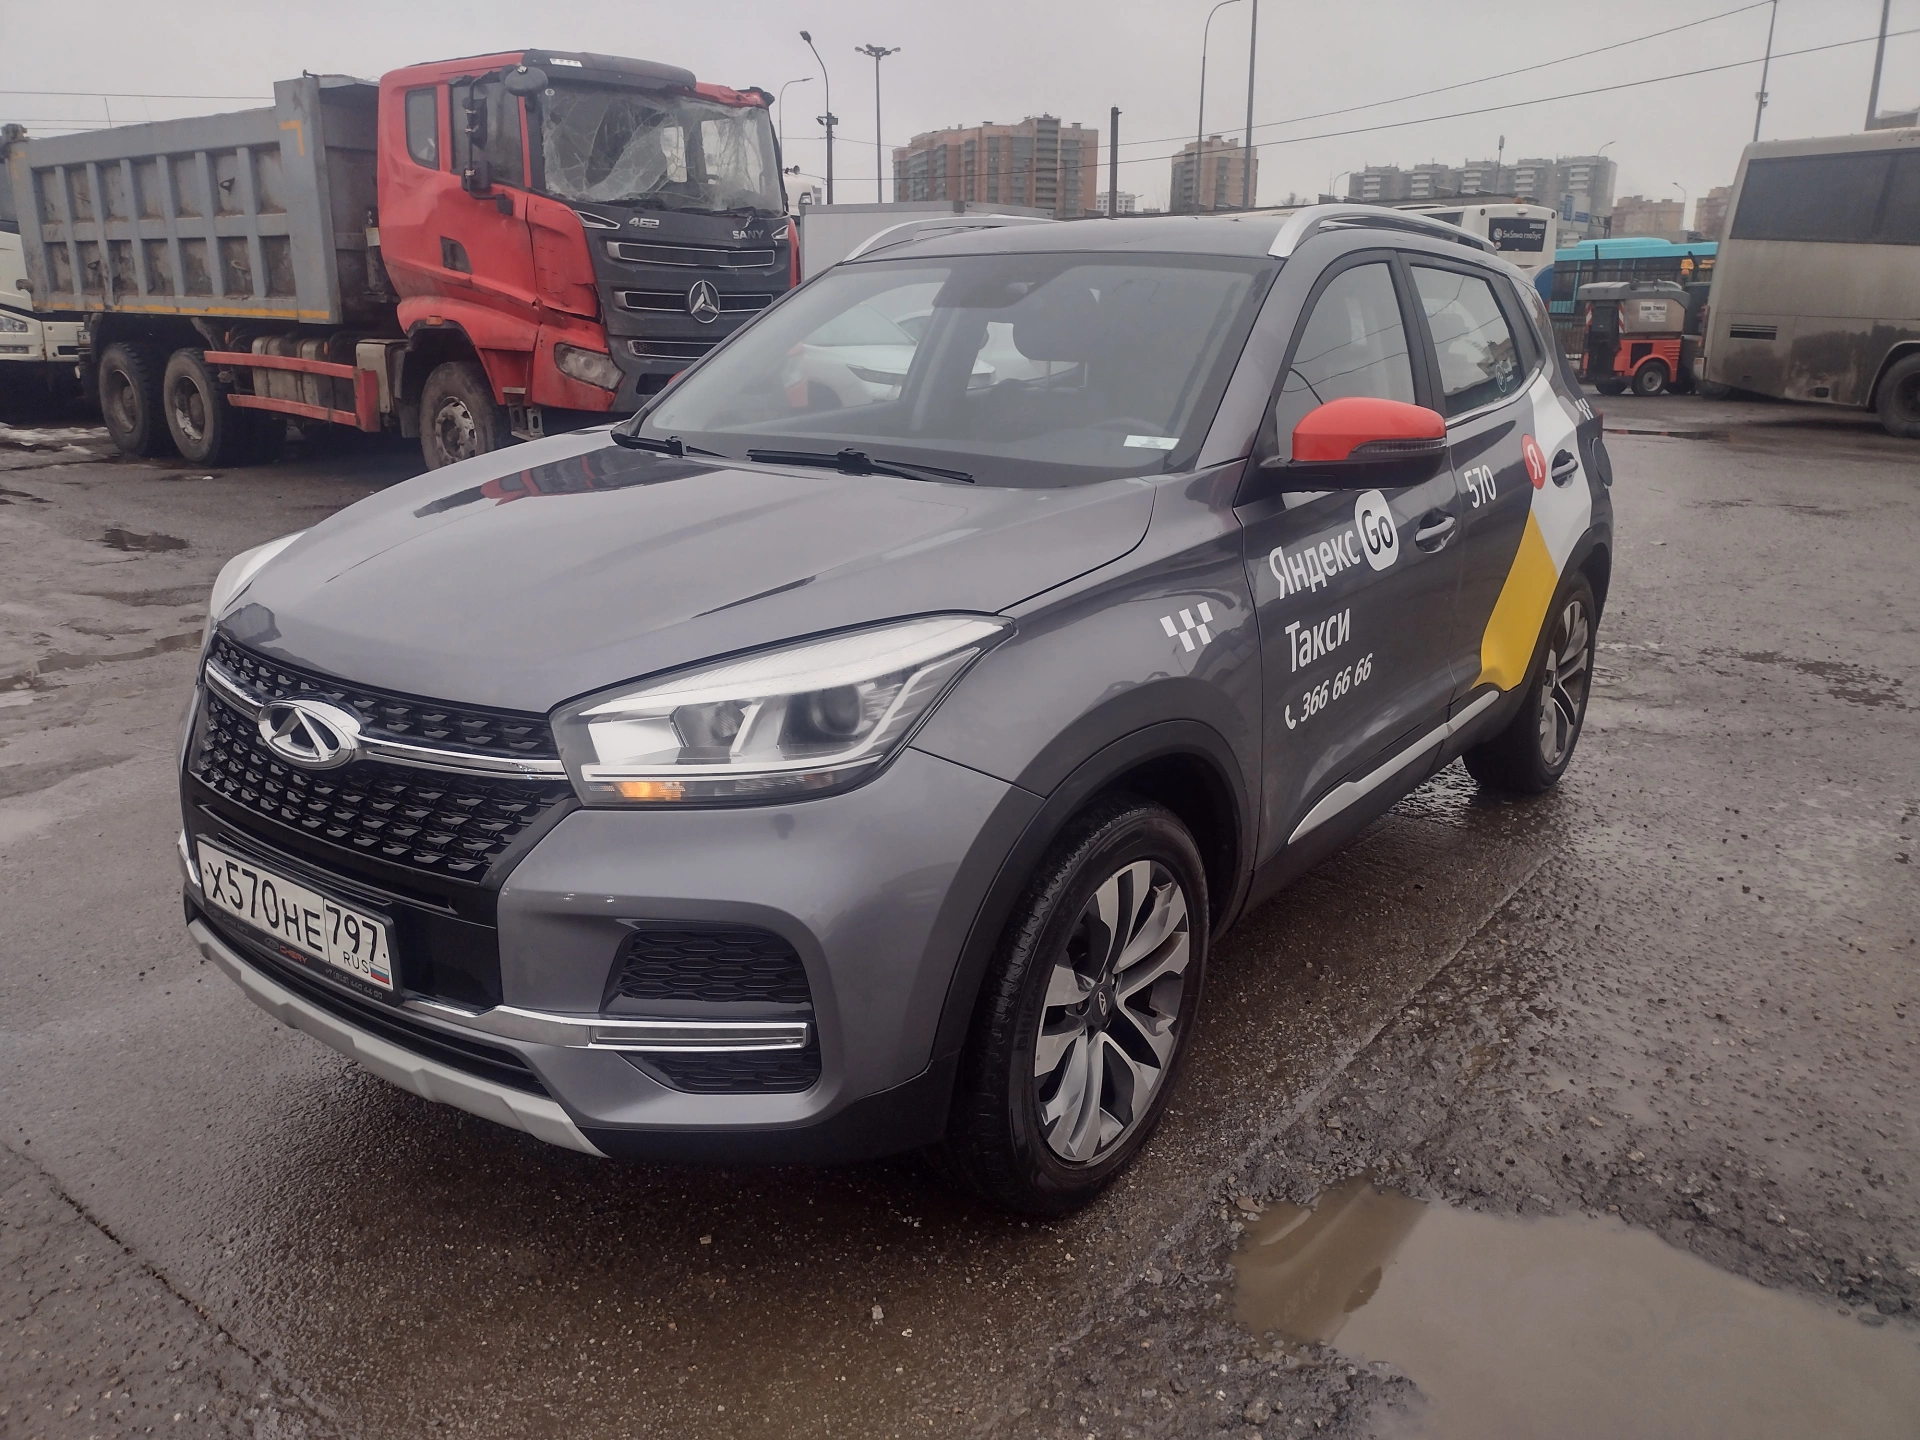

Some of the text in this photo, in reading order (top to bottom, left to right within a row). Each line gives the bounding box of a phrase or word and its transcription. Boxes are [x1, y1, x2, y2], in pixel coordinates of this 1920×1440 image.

[629, 217, 660, 229] 462
[732, 230, 764, 240] SANY
[1527, 443, 1543, 480] Я
[1463, 464, 1497, 509] 570
[1269, 509, 1394, 600] Яндекс Go
[1285, 608, 1350, 673] Такси
[1301, 653, 1373, 722] 366 66 66
[207, 860, 323, 952] Х570НЕ
[325, 904, 378, 962] 797
[280, 945, 308, 964] CHERY
[343, 950, 369, 974] RUS
